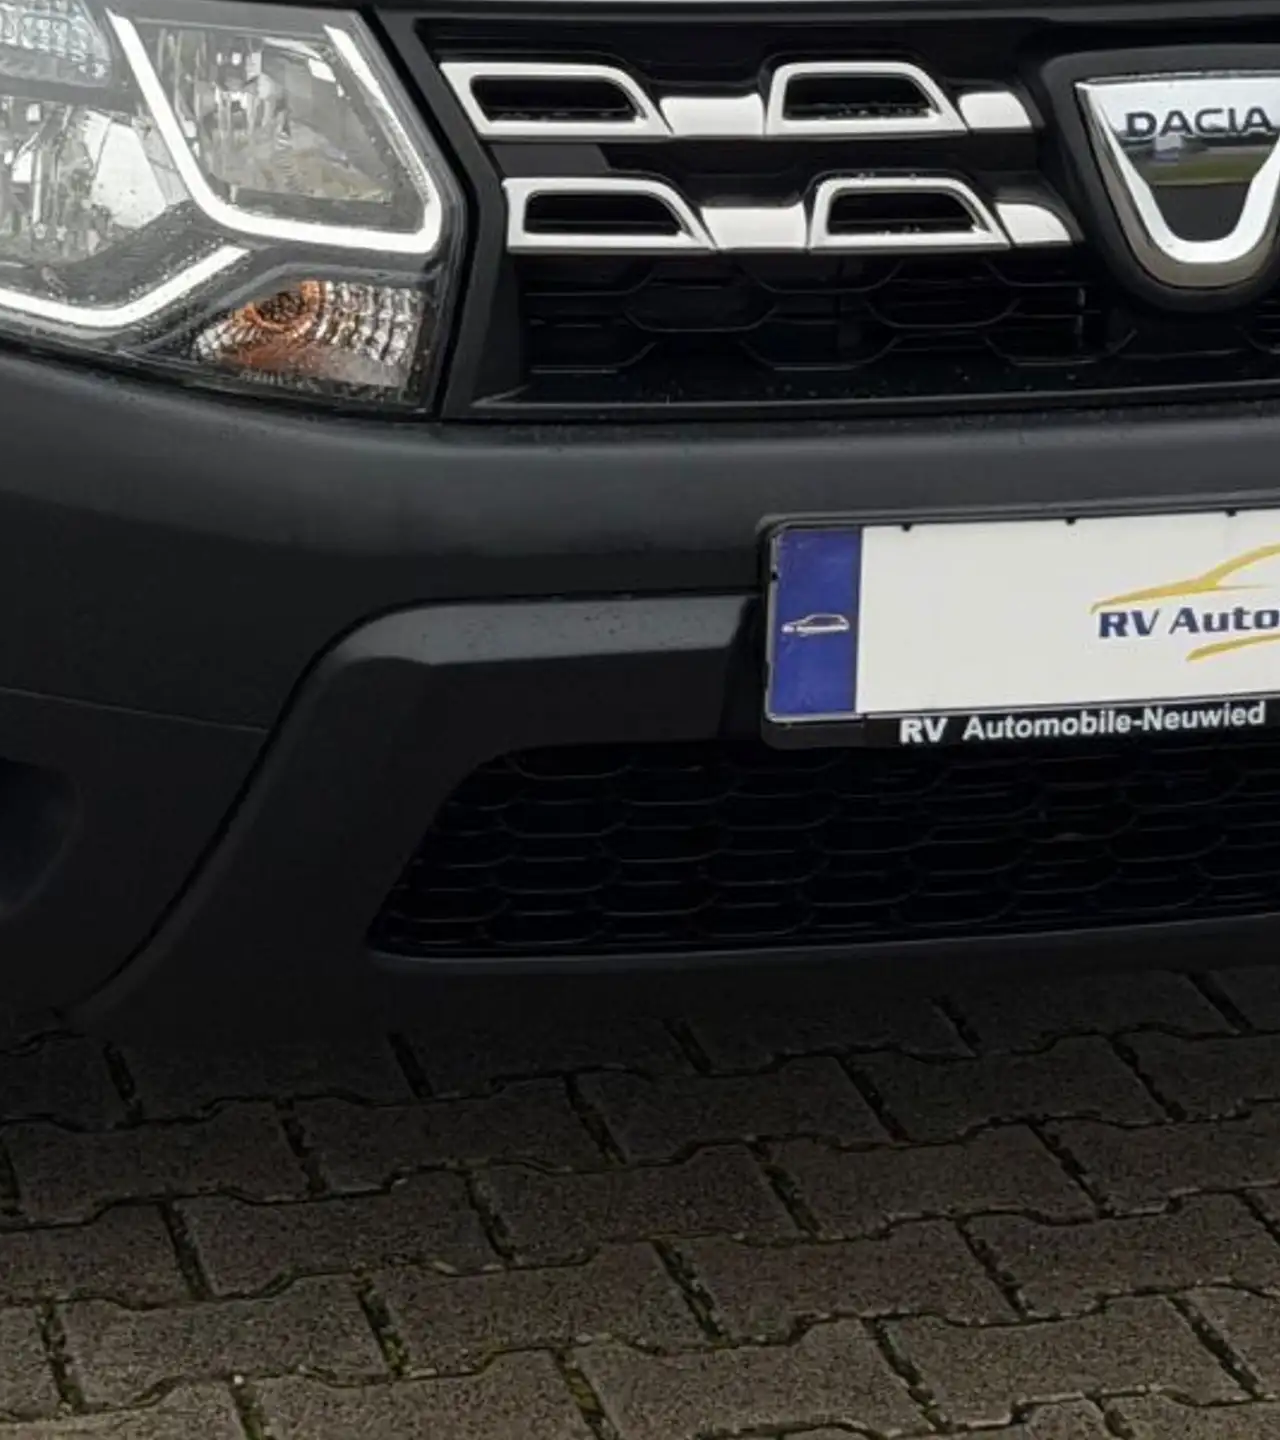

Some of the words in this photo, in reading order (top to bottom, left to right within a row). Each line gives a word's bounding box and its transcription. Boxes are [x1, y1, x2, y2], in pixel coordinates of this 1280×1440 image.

[1124, 106, 1272, 137] DACIA
[1098, 609, 1160, 639] RV
[899, 717, 948, 744] RV
[962, 700, 1266, 741] Automobile-Neuwied
